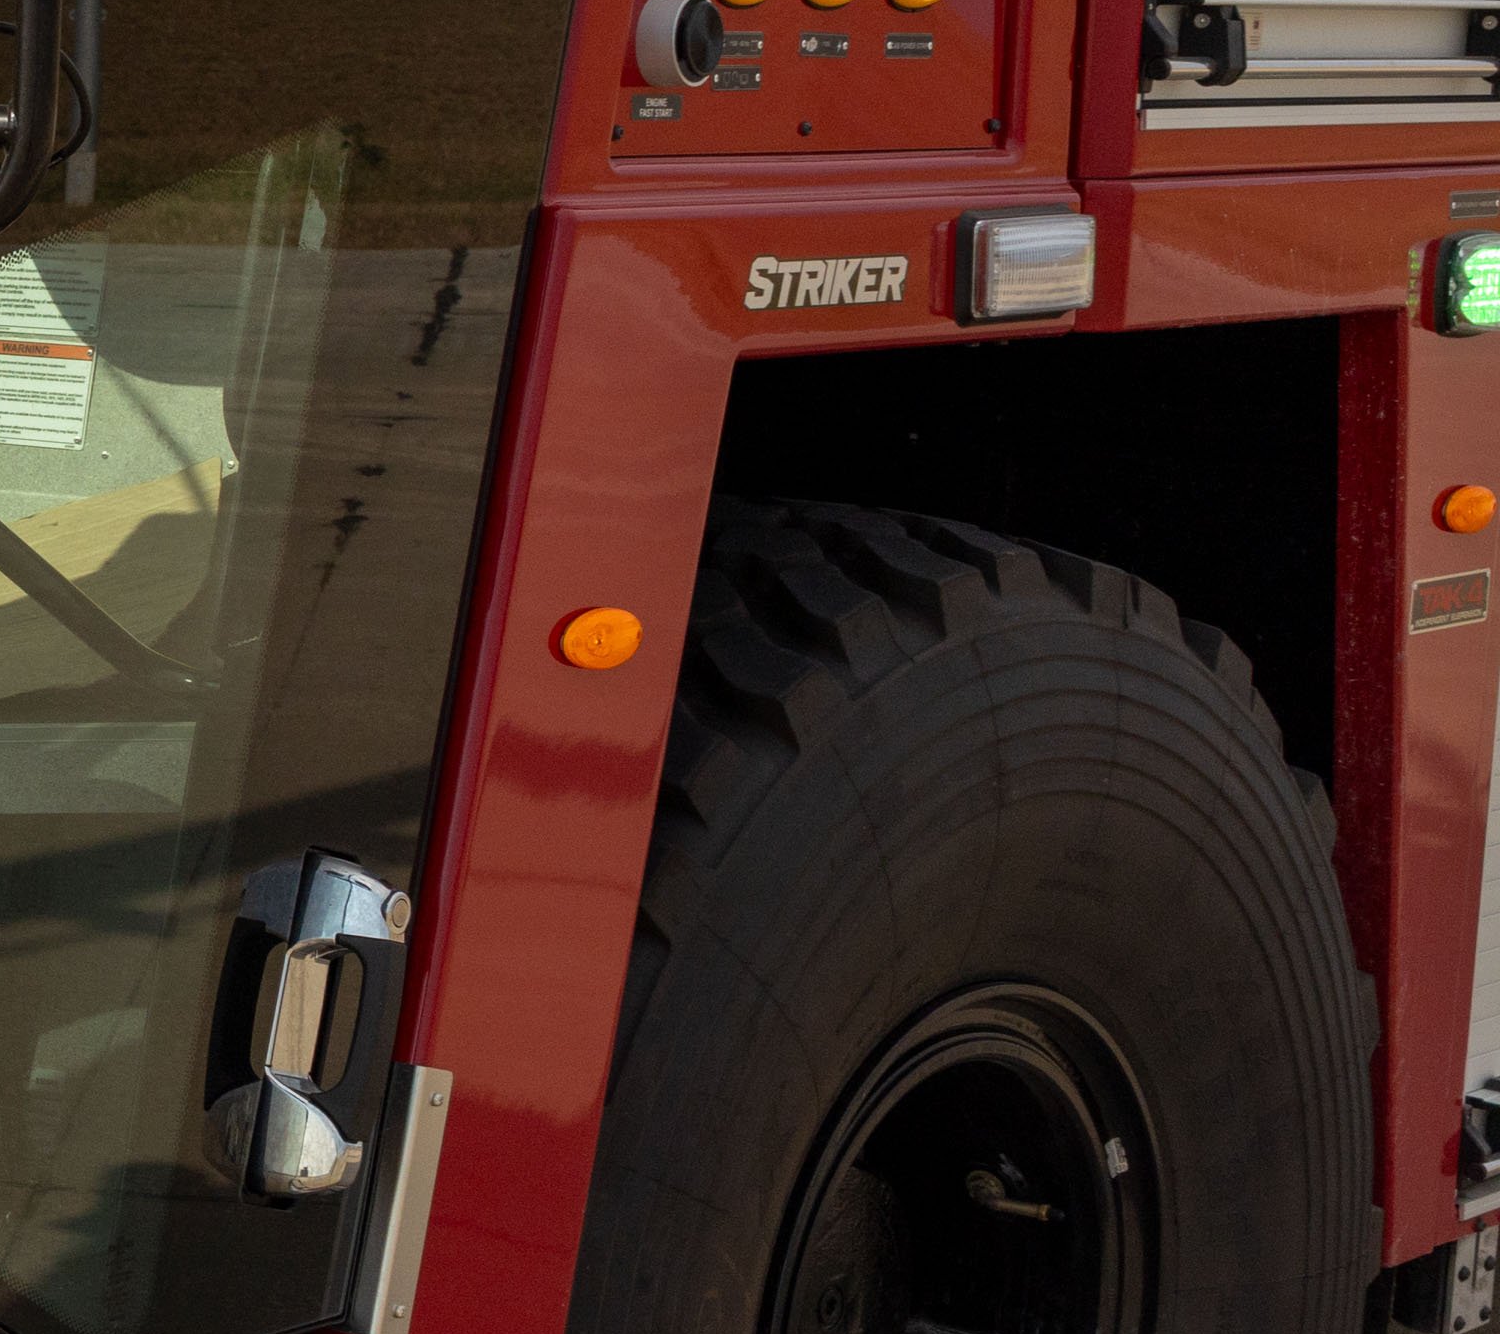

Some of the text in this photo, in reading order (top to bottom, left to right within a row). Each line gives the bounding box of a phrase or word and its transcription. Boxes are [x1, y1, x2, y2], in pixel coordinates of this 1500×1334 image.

[645, 97, 668, 107] ENGINE
[639, 108, 674, 117] FAST START
[745, 256, 907, 309] STRIKER
[2, 343, 50, 355] WARNING
